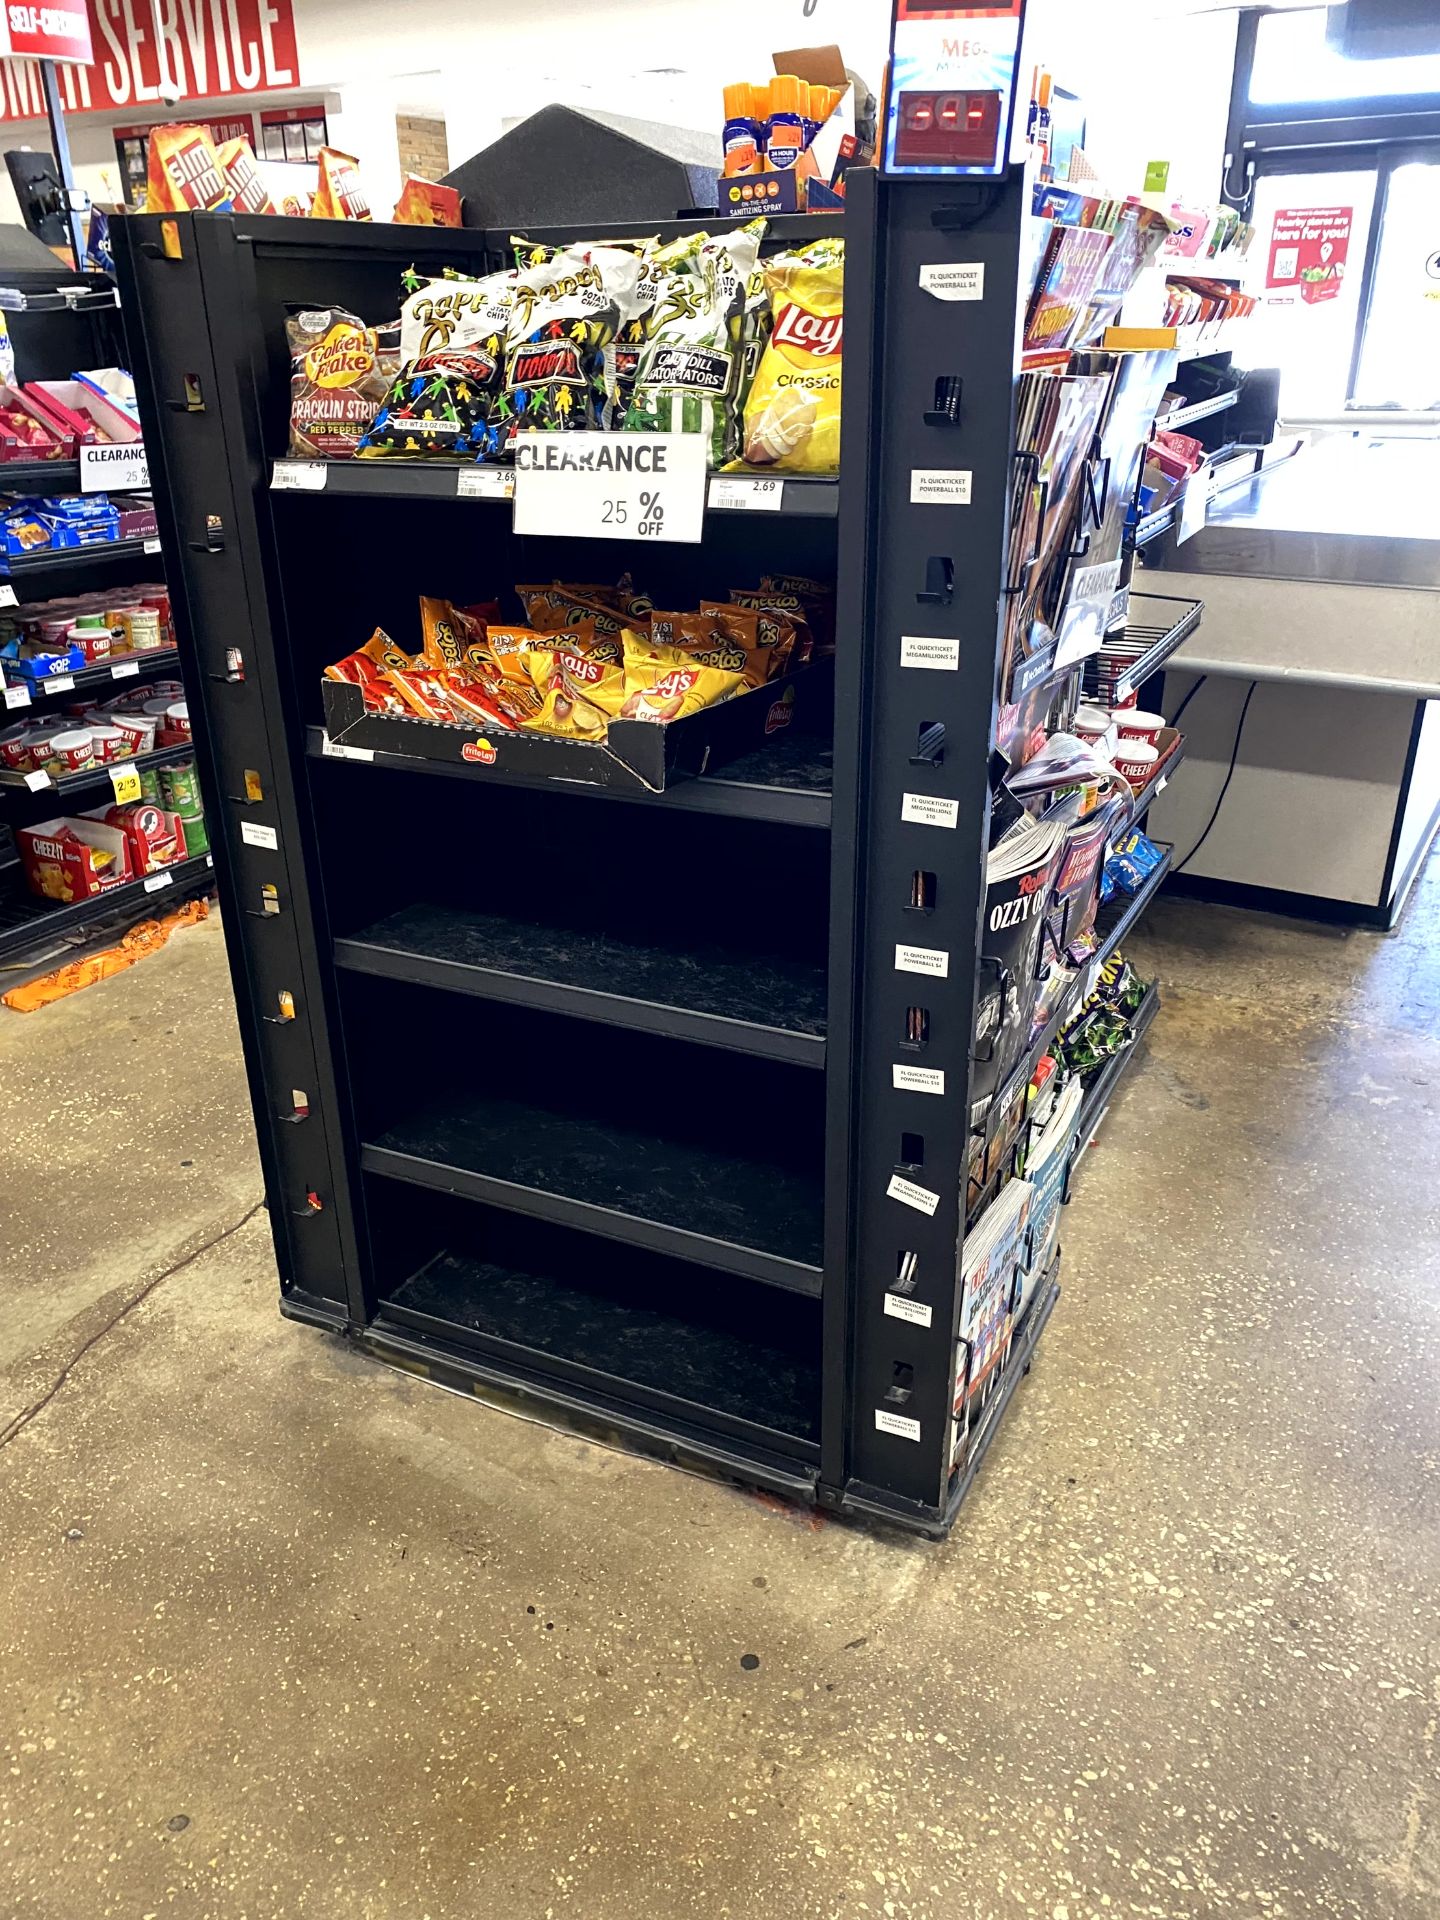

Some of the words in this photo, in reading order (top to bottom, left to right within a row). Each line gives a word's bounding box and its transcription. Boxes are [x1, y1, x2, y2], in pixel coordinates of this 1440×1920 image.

[95, 0, 293, 105] SERVICE
[167, 143, 213, 190] Slim
[189, 167, 227, 212] Jim
[729, 205, 763, 217] SANITIZING
[763, 202, 782, 214] SPRAY
[1334, 217, 1349, 225] are
[1273, 227, 1300, 240] here
[1302, 226, 1321, 240] for
[1321, 225, 1349, 242] you!
[938, 272, 977, 280] QUICKTICKET
[930, 281, 967, 289] POWERBALL
[310, 334, 363, 363] Golden
[315, 355, 368, 381] Flake
[688, 355, 713, 371] DILL
[777, 373, 841, 389] Classic
[292, 400, 344, 420] CRACKLIN
[310, 425, 327, 434] RED
[328, 425, 364, 435] PEPPER
[87, 447, 146, 463] CLEARANC
[514, 443, 668, 474] CLEARANCE
[126, 471, 138, 483] 25
[496, 471, 515, 482] 2.69
[752, 481, 776, 492] 2.69
[601, 500, 628, 524] 25
[639, 491, 665, 522] %
[637, 521, 665, 537] OFF
[1076, 566, 1118, 599] CLEARANCE
[653, 622, 673, 633] 2/$1
[911, 804, 952, 815] MEGAMILLIONS
[918, 798, 953, 808] QUICKTICKET
[32, 837, 65, 862] CHEEZ-IT
[989, 893, 1034, 932] OZZY
[904, 958, 934, 967] POWERBALL
[910, 952, 943, 962] QUICKTICKET
[900, 1076, 930, 1085] POWERBALL
[907, 1071, 939, 1080] QUICKTICKET
